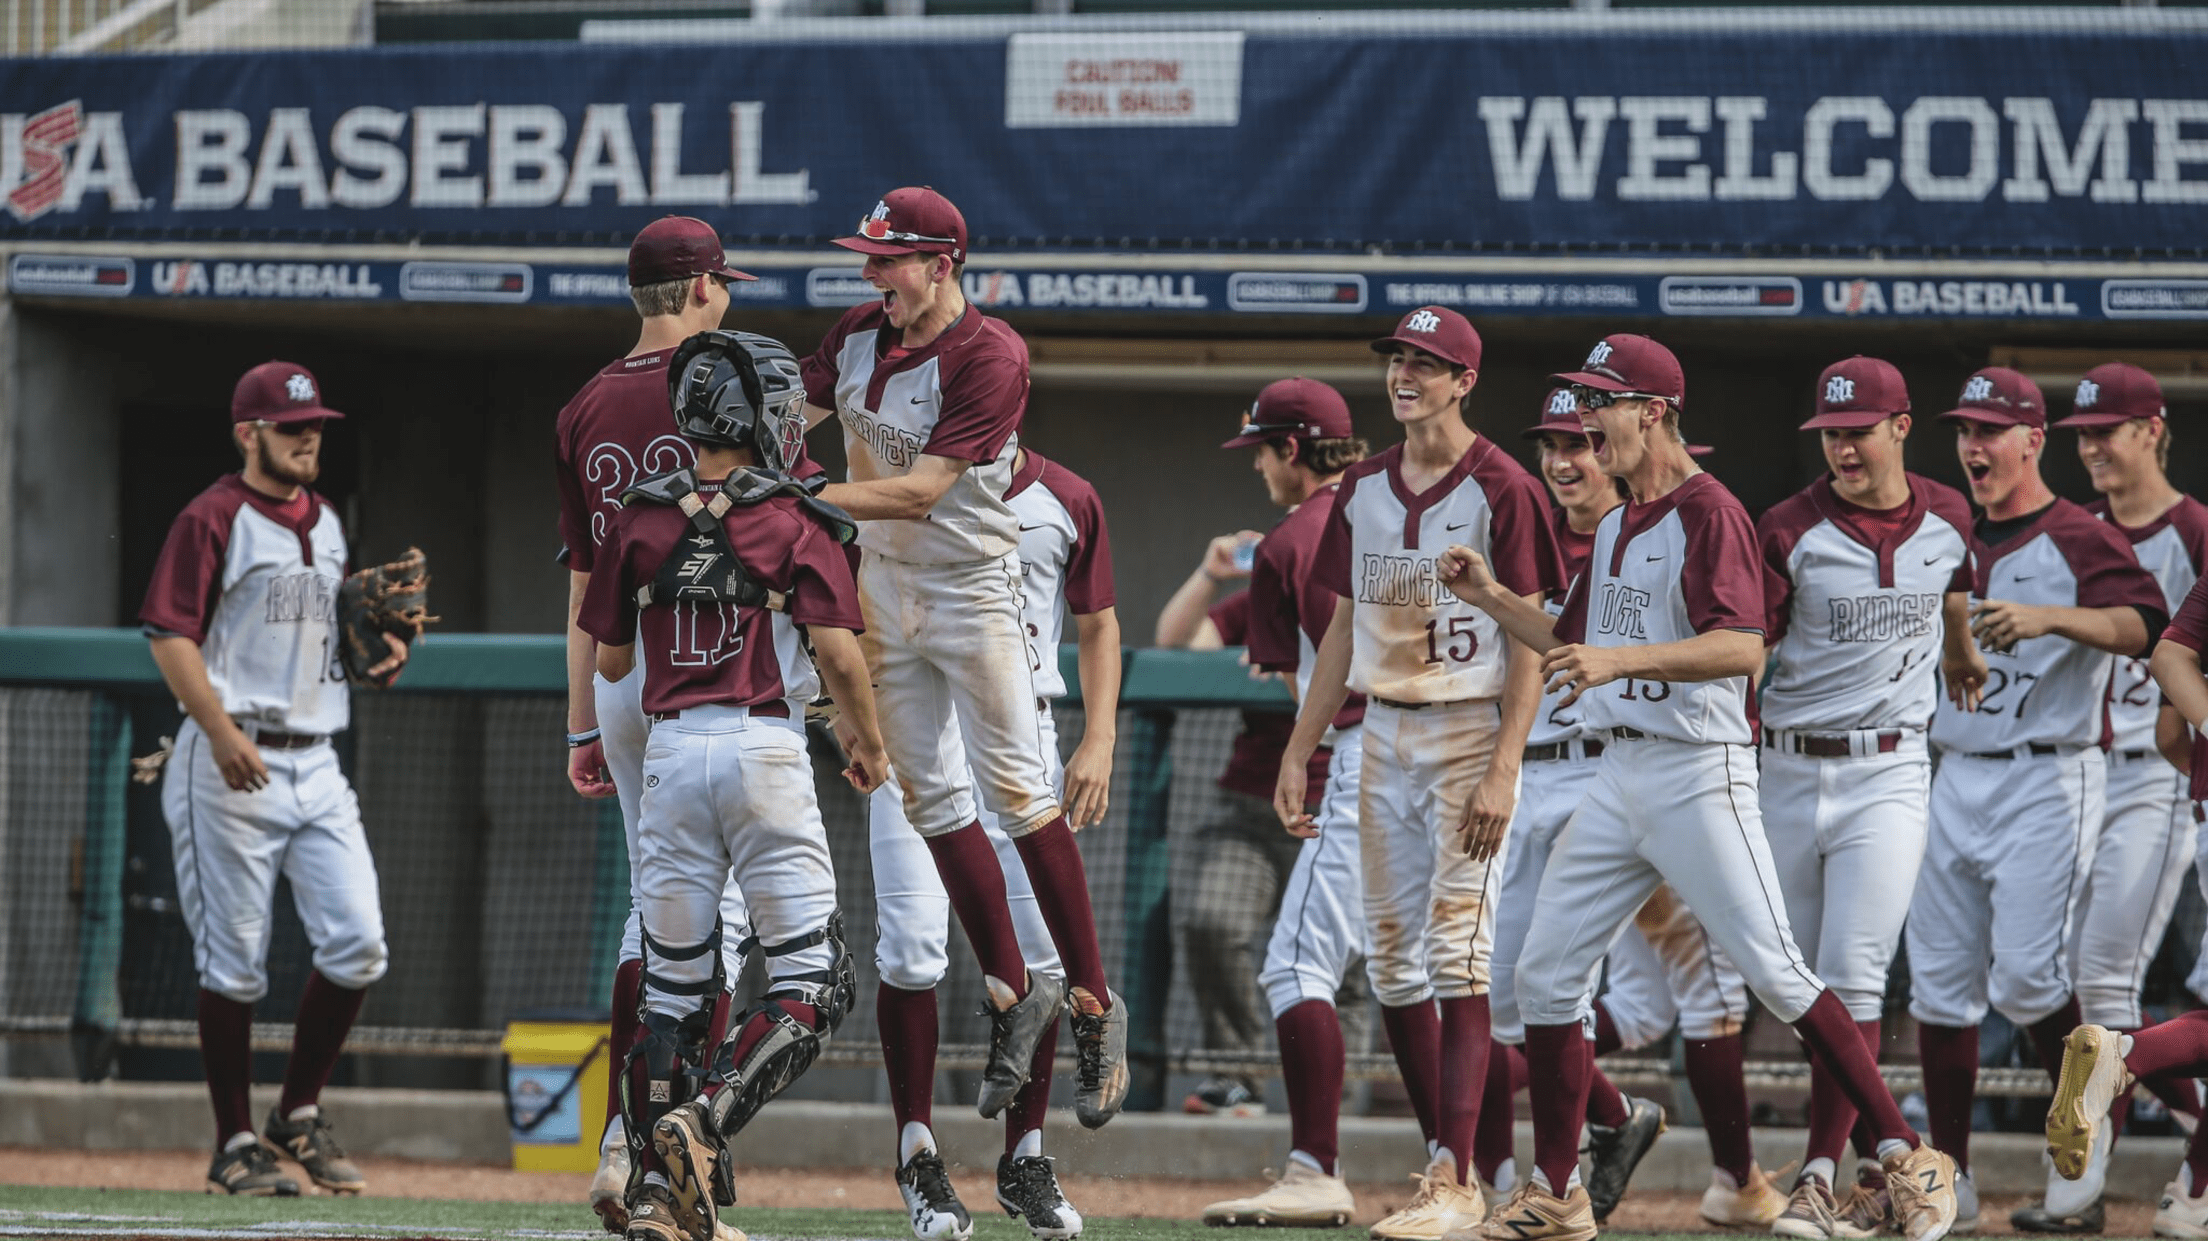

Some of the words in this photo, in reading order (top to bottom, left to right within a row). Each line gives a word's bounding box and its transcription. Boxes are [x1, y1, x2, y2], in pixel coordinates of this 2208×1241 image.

[1055, 89, 1110, 115] FOUL
[1118, 88, 1196, 115] BALLS
[172, 102, 812, 211] BASEBALL
[1478, 96, 2208, 203] WELCOME
[153, 259, 210, 296] USA
[213, 262, 381, 298] BASEBALL
[962, 271, 1024, 307] USA
[1027, 273, 1208, 308] BASEBALL
[1822, 279, 1888, 316] USA
[1892, 281, 2080, 316] BASEBALL
[264, 572, 338, 623] RIDG
[1598, 583, 1651, 640] DGE
[1425, 616, 1479, 664] 15
[1976, 667, 2040, 718] 27
[2109, 658, 2151, 706] 2
